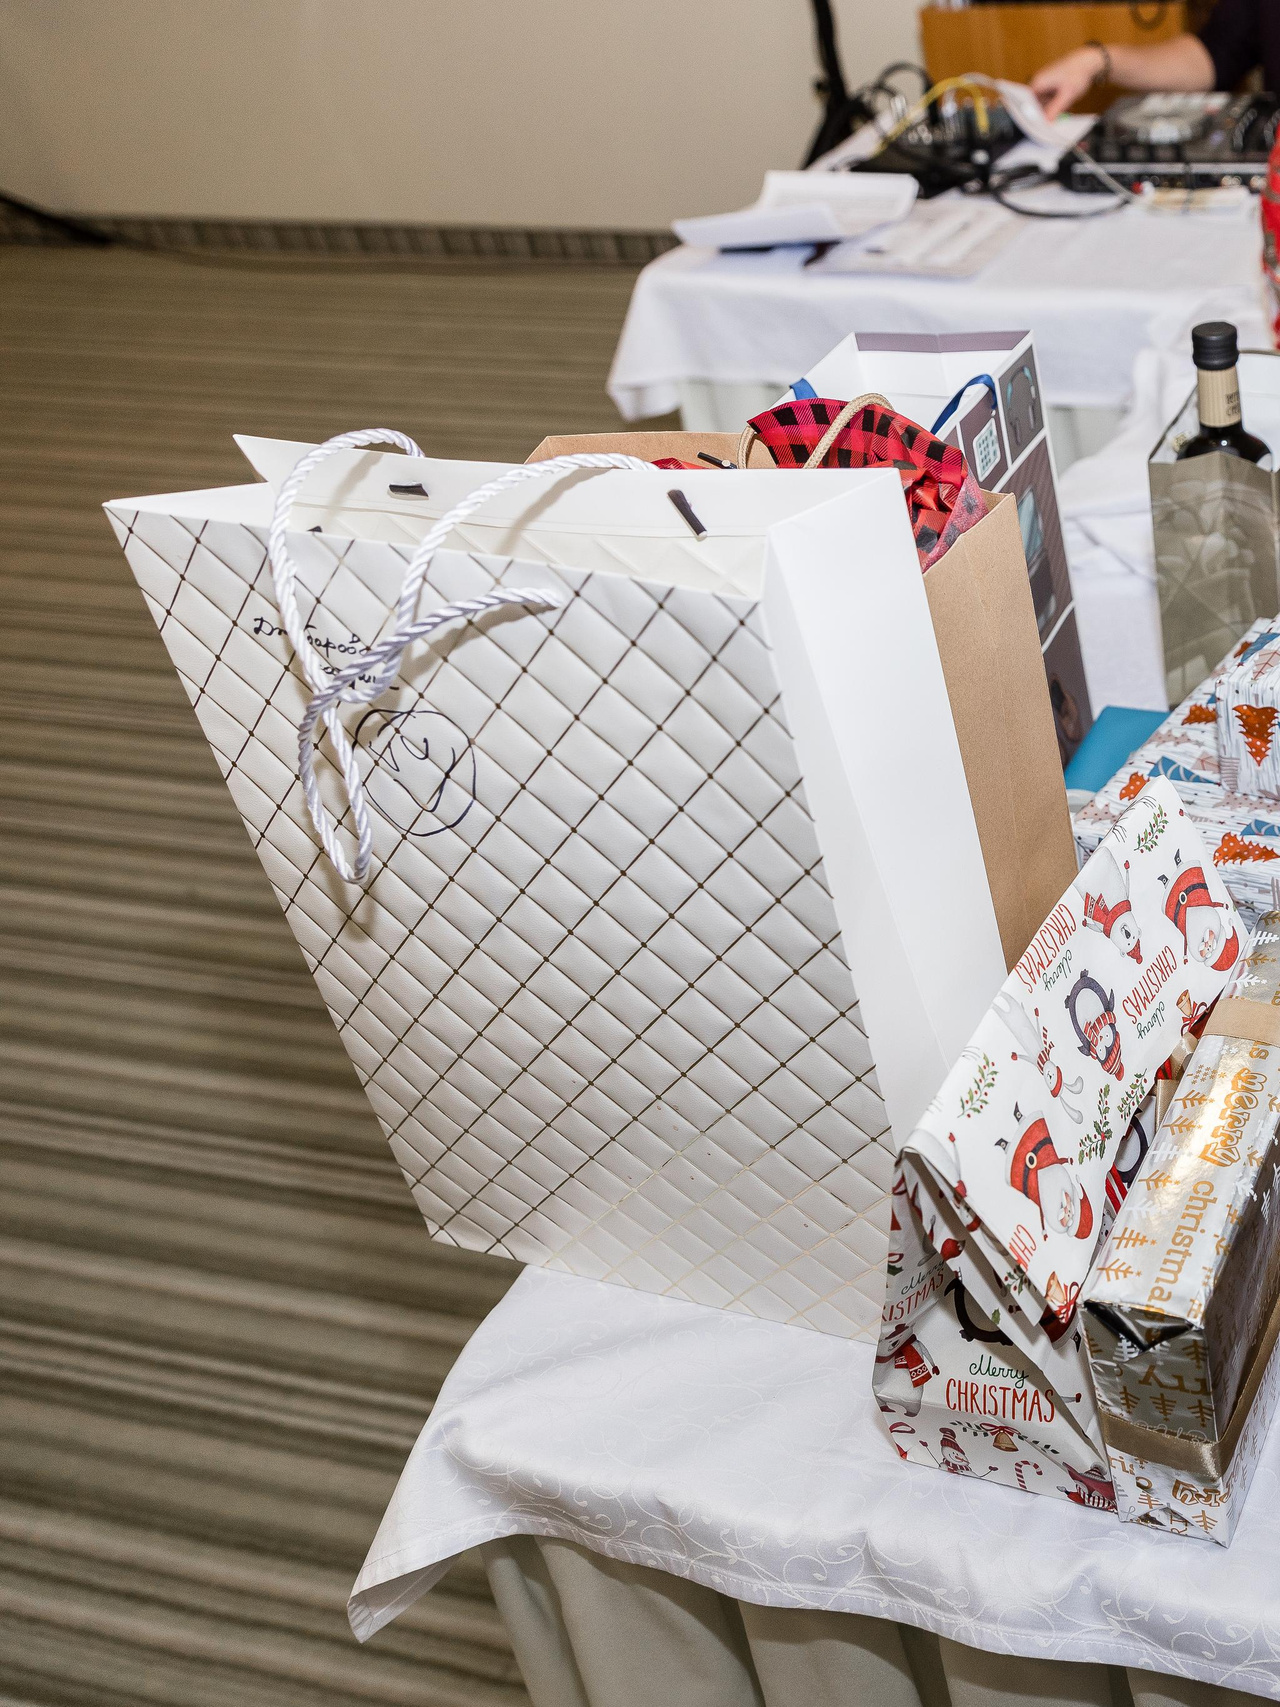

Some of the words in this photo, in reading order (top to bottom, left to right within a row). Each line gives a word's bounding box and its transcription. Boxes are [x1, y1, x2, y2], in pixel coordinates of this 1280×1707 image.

[1014, 903, 1077, 994] CHRISTMAS
[1042, 949, 1072, 991] Merry
[1122, 945, 1177, 1024] CHRISTMAS
[1136, 1001, 1165, 1039] Merry
[969, 1355, 1029, 1388] Merry
[946, 1378, 1055, 1423] CHRISTMAS
